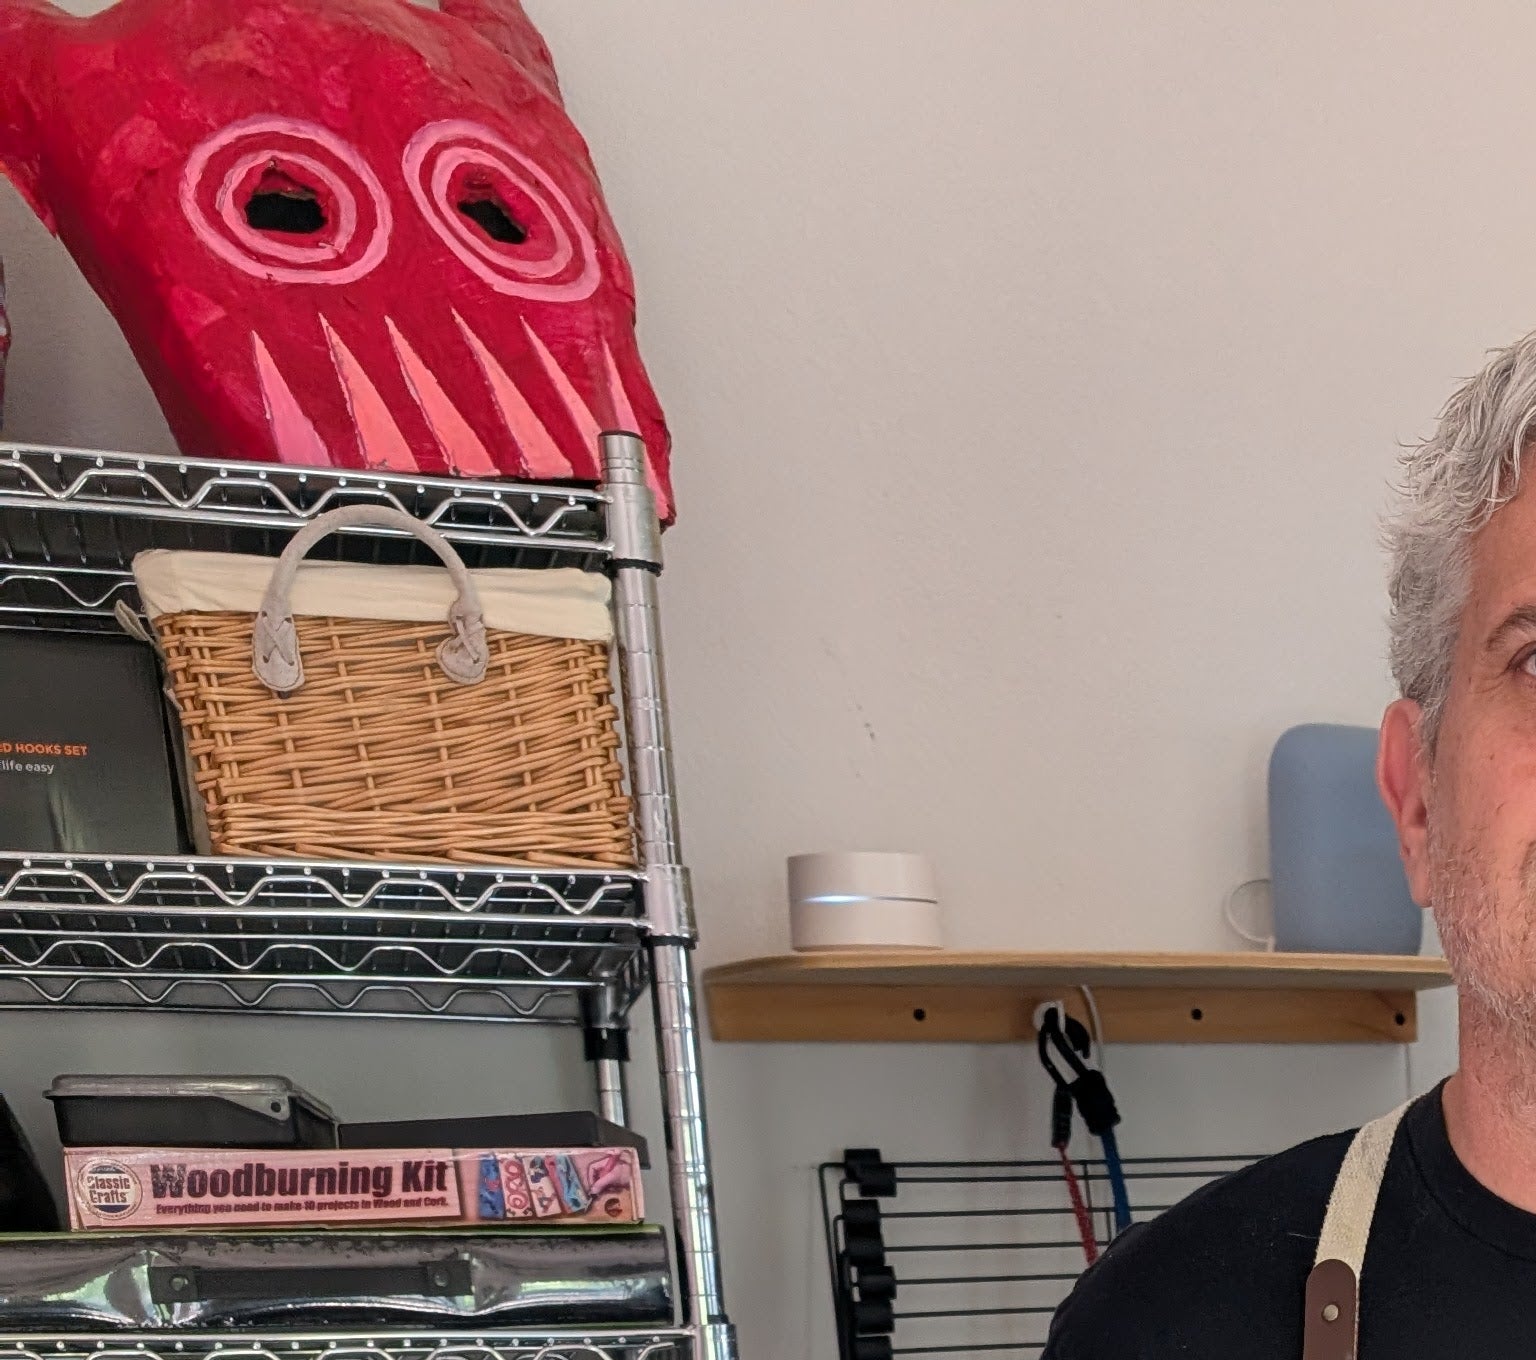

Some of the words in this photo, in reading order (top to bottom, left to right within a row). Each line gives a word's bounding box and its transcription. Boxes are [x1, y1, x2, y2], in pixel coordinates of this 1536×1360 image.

[15, 743, 62, 755] HOOKS
[64, 745, 89, 756] SET
[25, 763, 55, 775] easy
[86, 1175, 131, 1190] Classic
[150, 1161, 393, 1199] Woodburning
[402, 1160, 448, 1193] Kit
[89, 1189, 128, 1203] Crafts
[156, 1203, 211, 1215] Everything
[213, 1204, 232, 1213] you
[262, 1202, 272, 1212] to
[274, 1201, 302, 1211] make
[317, 1200, 360, 1212] projects
[374, 1198, 402, 1209] Wood
[404, 1198, 421, 1208] and
